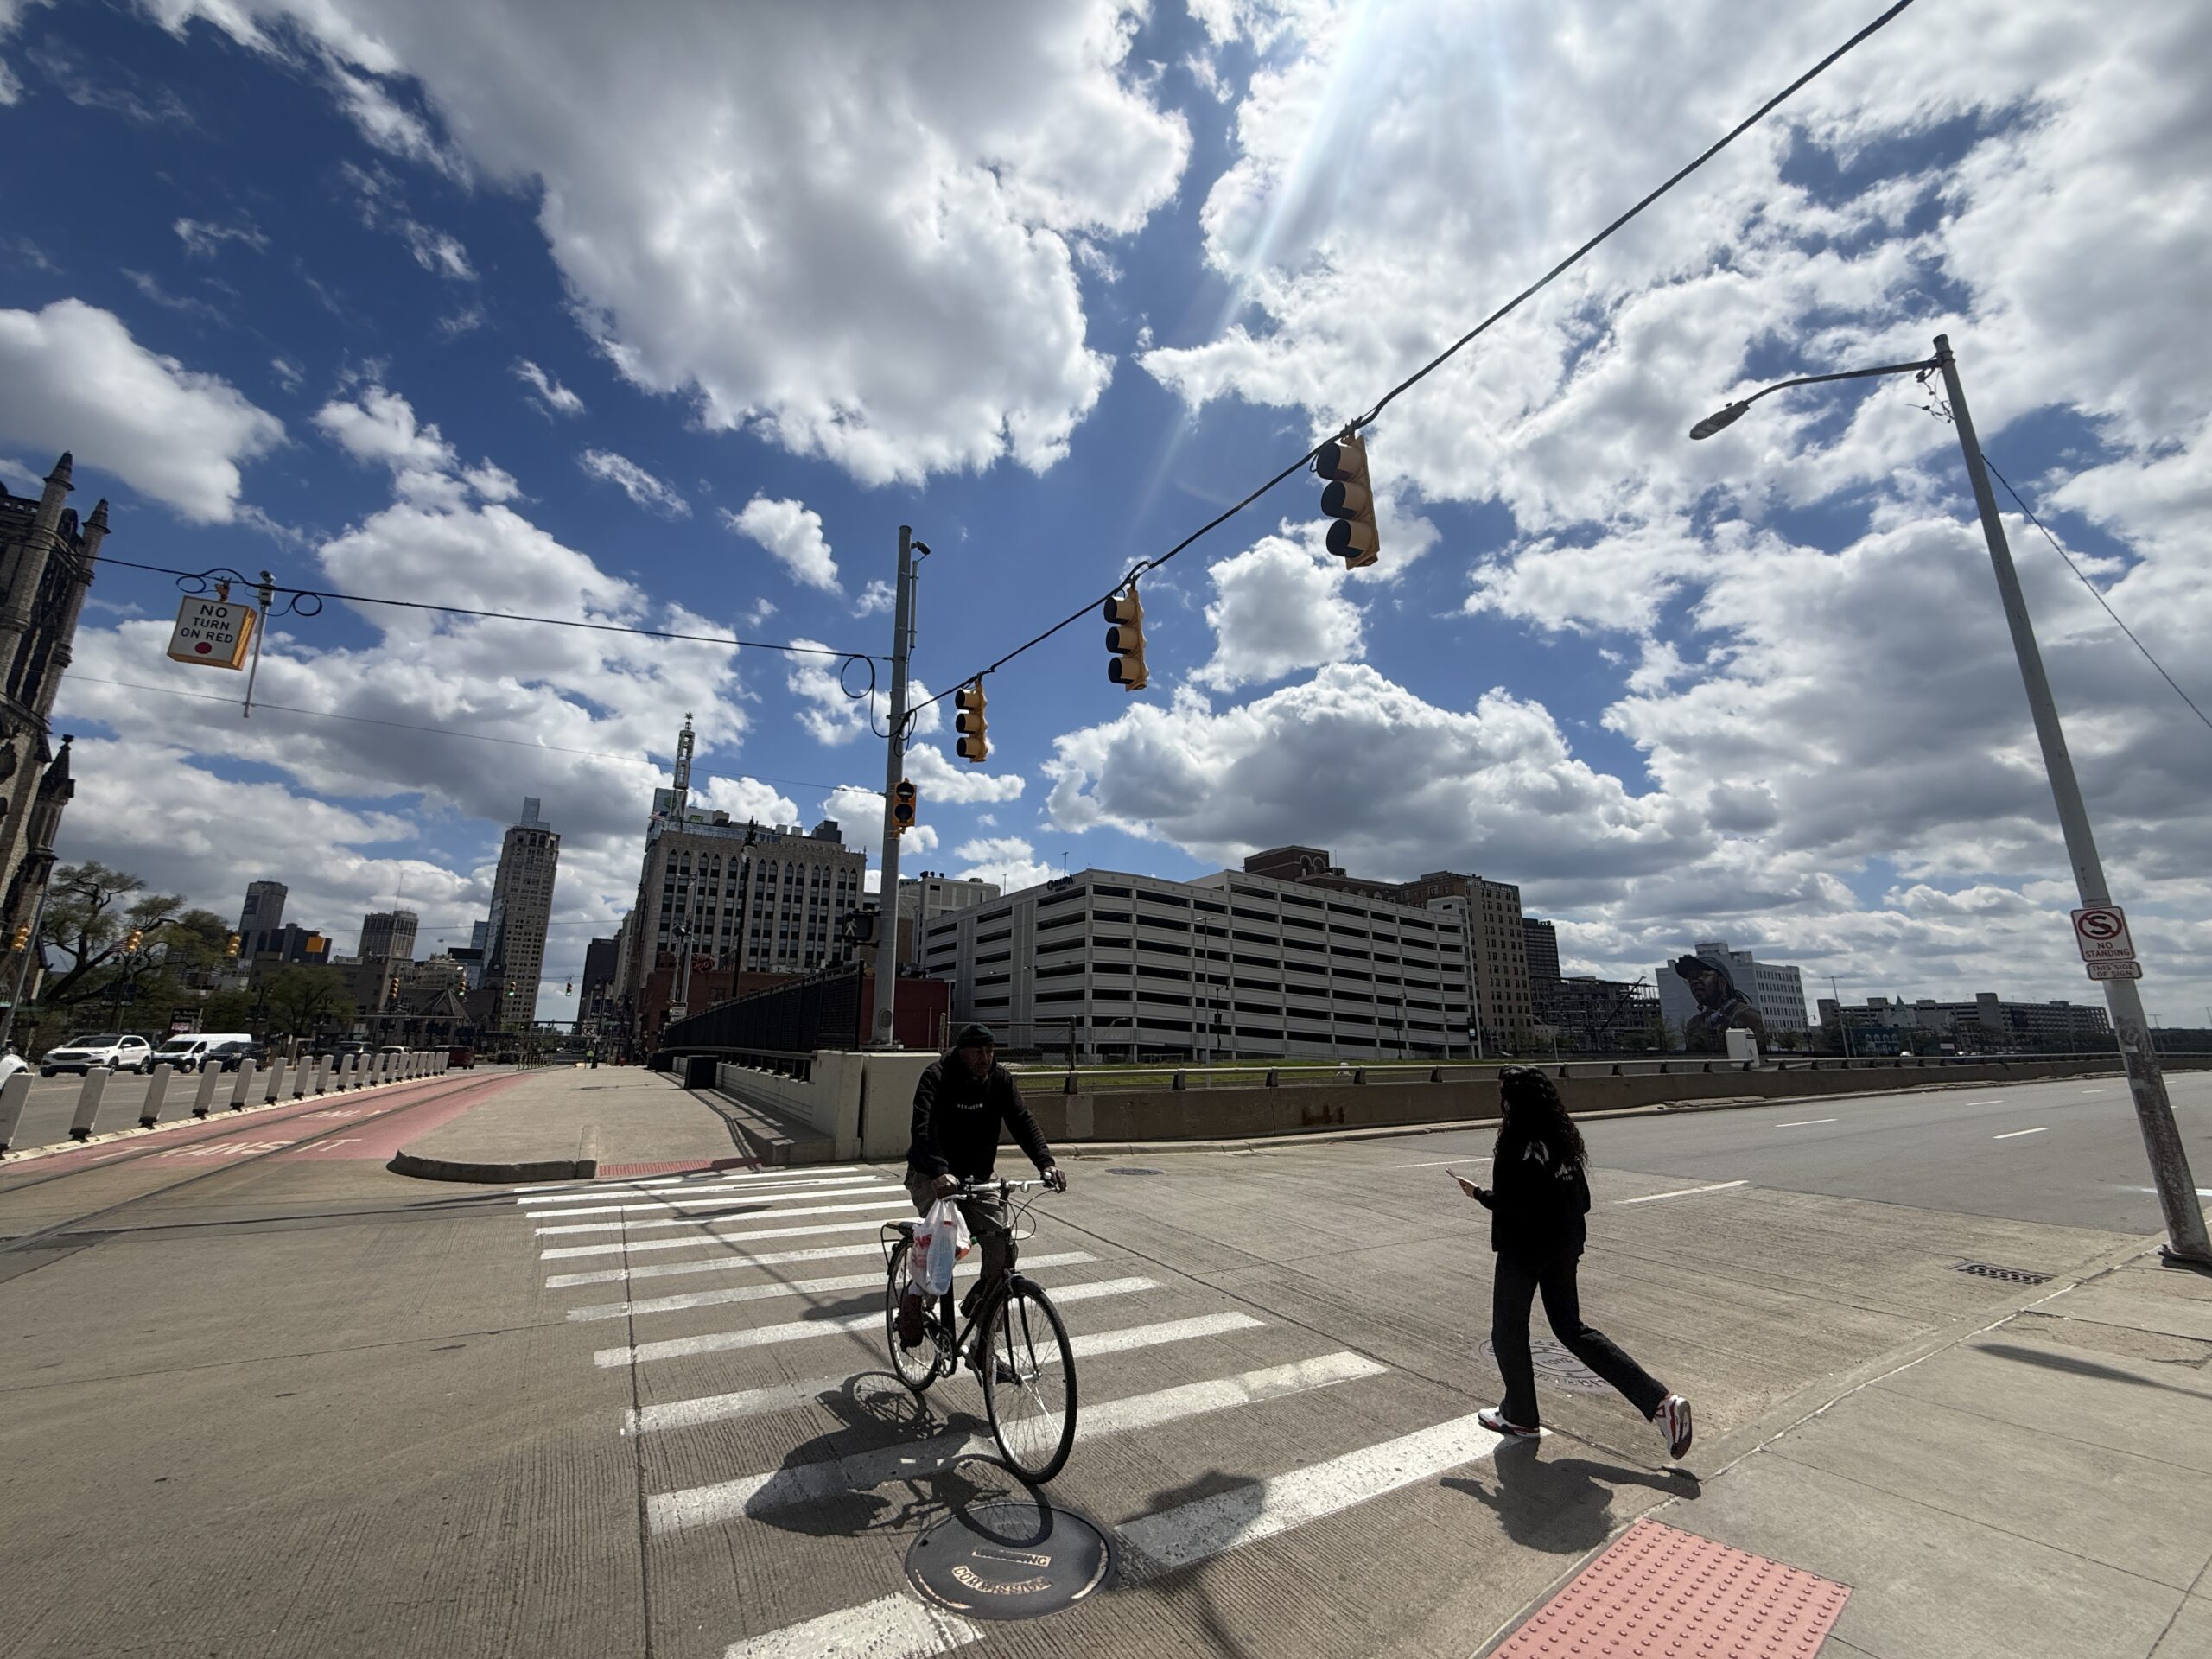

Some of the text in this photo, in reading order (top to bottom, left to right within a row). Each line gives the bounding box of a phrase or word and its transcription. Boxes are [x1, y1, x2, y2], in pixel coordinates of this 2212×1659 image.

[200, 604, 228, 619] NO
[193, 616, 230, 631] TURN
[181, 627, 233, 644] ON RED
[2085, 949, 2130, 958] STANDING
[88, 1138, 363, 1161] TRANSIT
